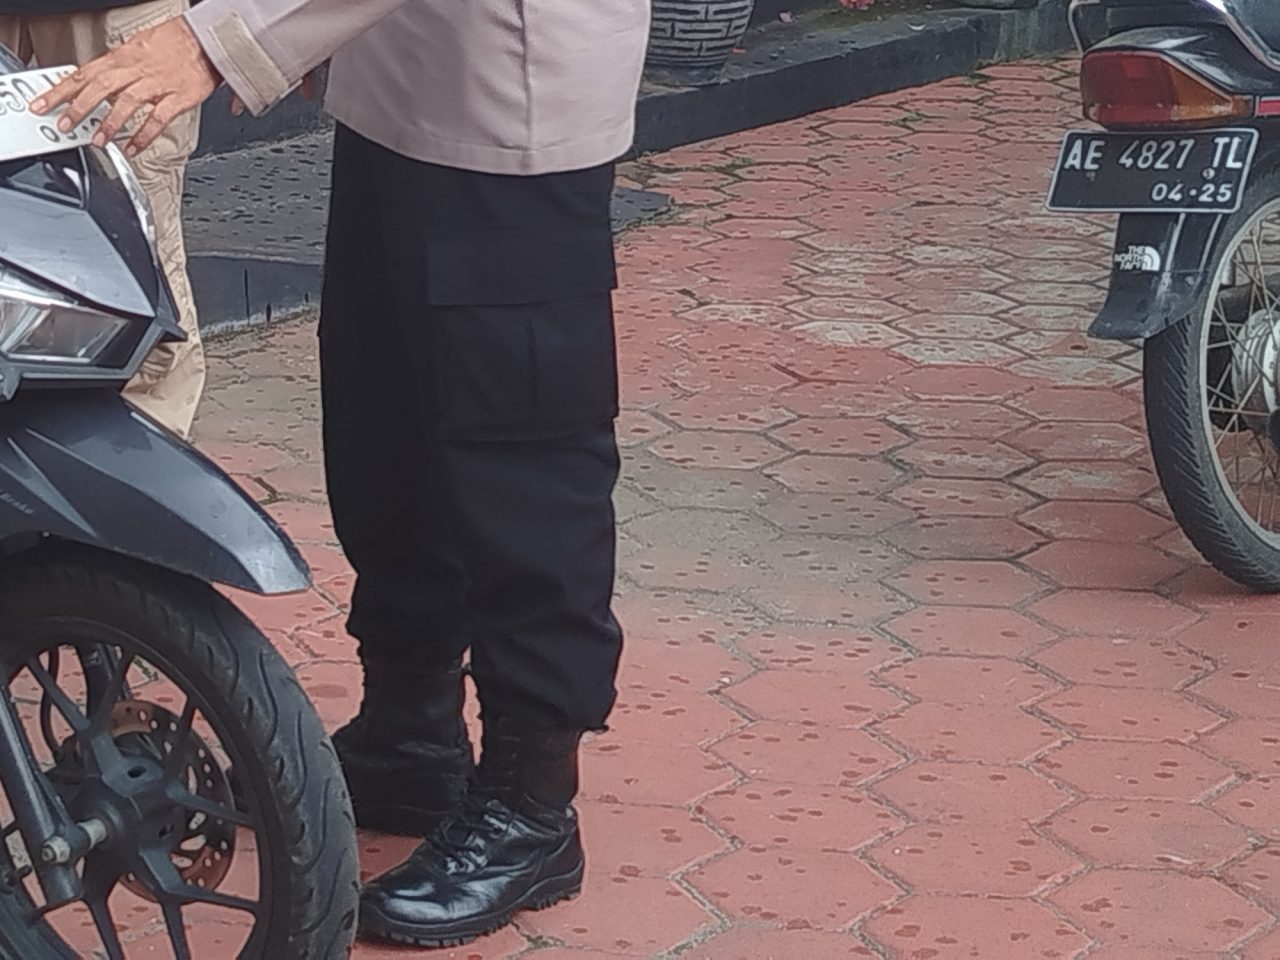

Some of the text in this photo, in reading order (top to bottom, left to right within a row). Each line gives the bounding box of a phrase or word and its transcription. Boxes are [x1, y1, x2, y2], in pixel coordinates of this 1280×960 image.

[1063, 136, 1245, 171] AE 4827 TL
